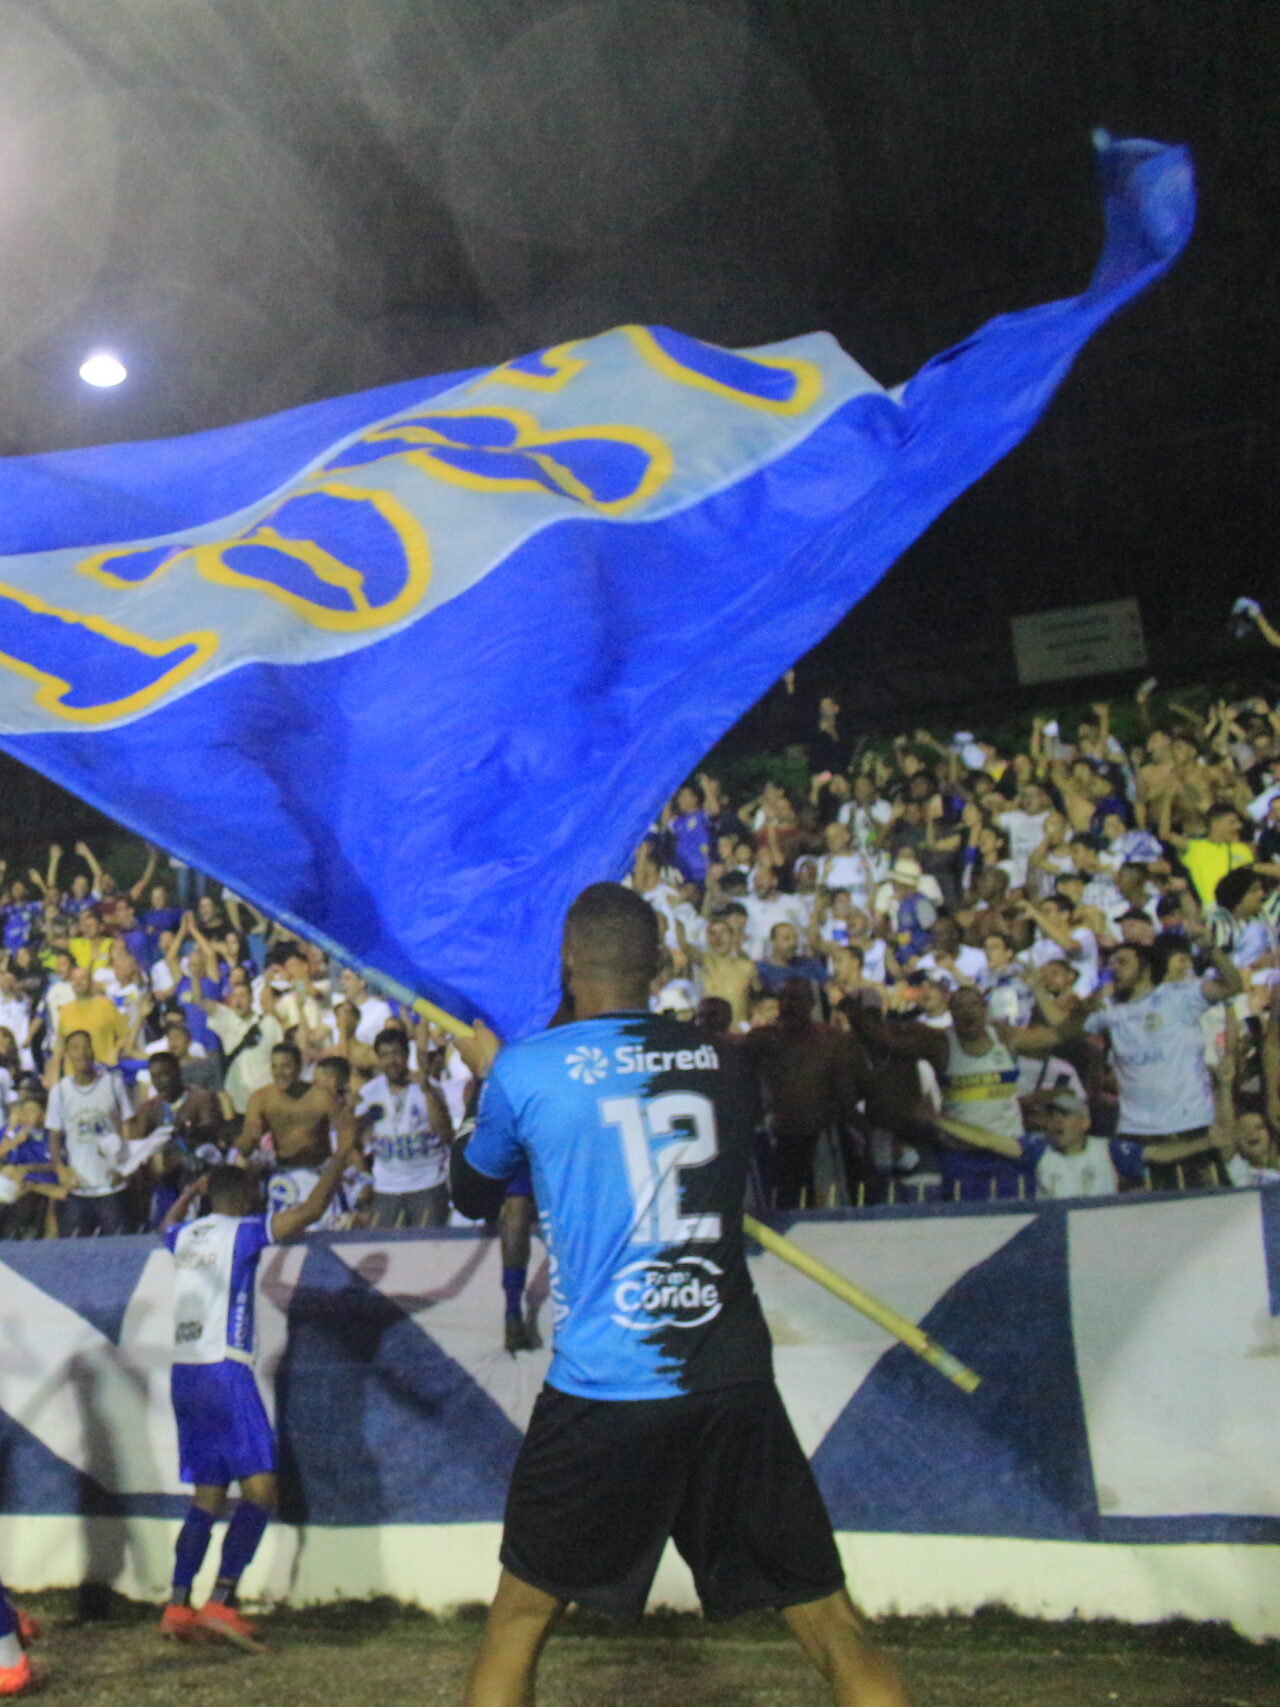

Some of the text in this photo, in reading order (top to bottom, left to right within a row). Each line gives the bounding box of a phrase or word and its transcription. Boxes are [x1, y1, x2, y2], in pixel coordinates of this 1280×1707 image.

[614, 1043, 719, 1074] Sicredi
[600, 1090, 722, 1243] 12
[614, 1278, 719, 1312] Conde
